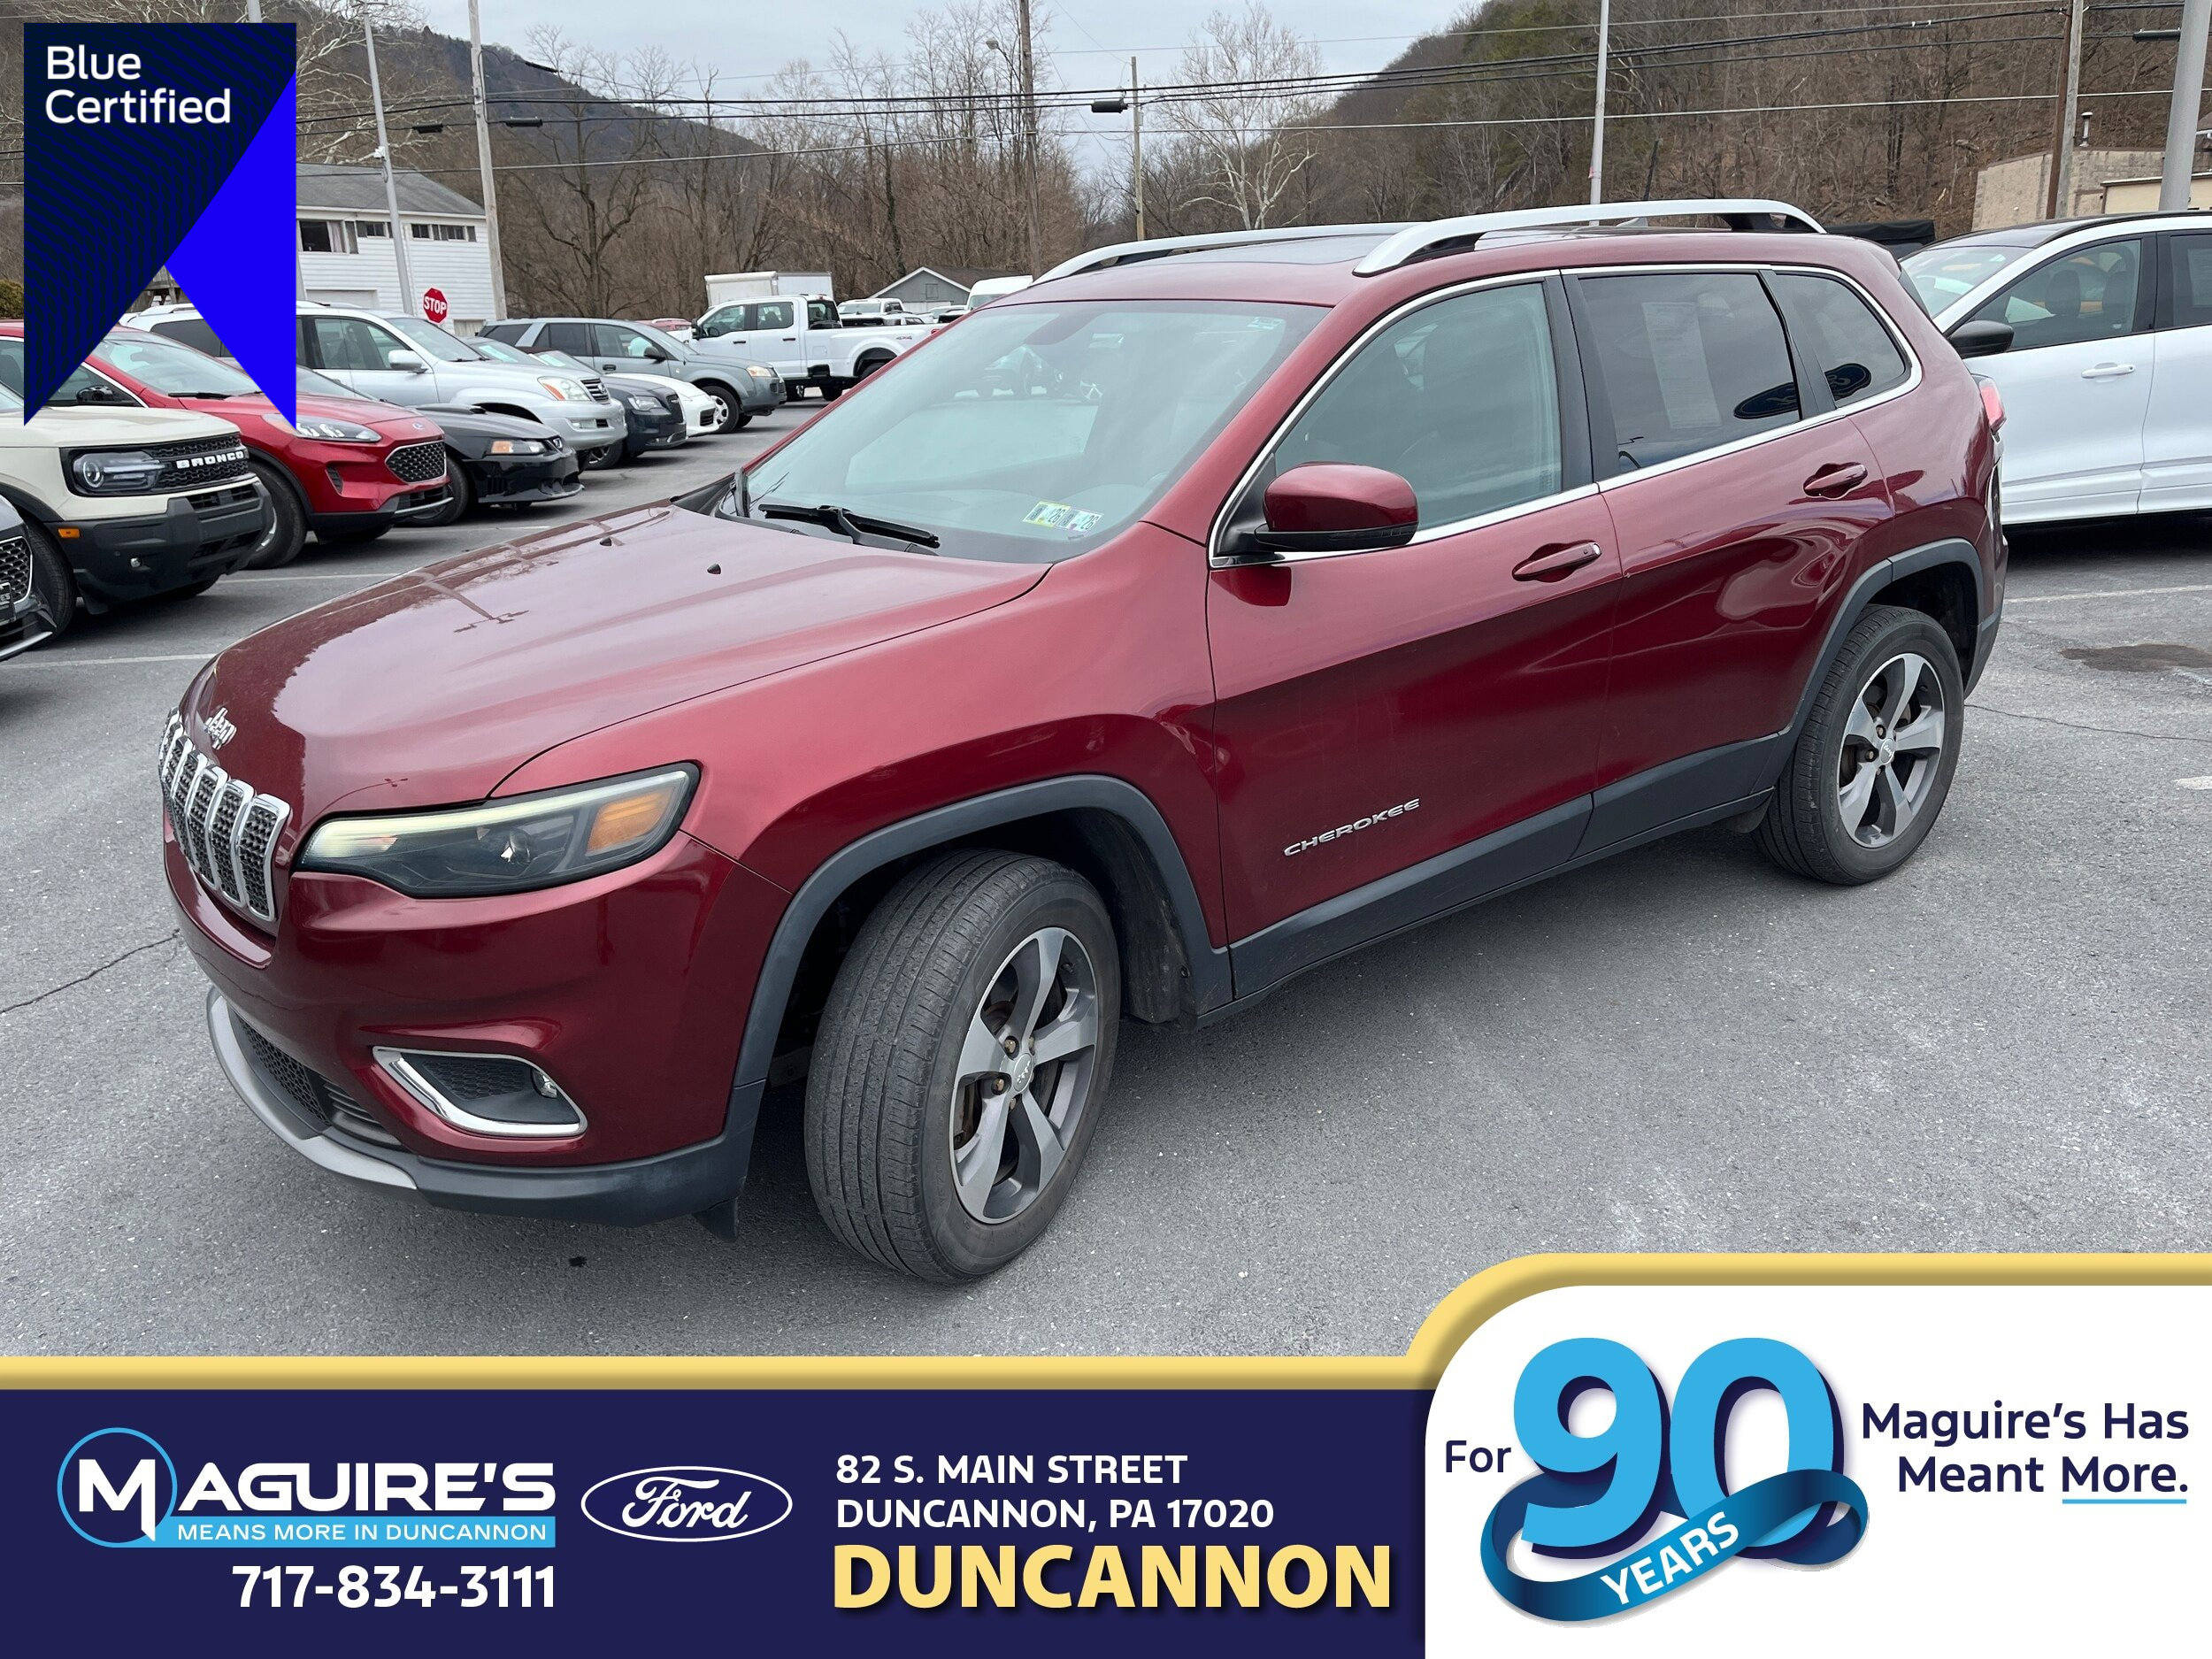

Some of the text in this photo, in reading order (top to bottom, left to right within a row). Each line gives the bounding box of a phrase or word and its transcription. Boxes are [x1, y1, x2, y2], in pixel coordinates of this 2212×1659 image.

[425, 296, 447, 314] STOP
[176, 450, 244, 469] BRONCO
[1284, 798, 1420, 856] CHEROKEE
